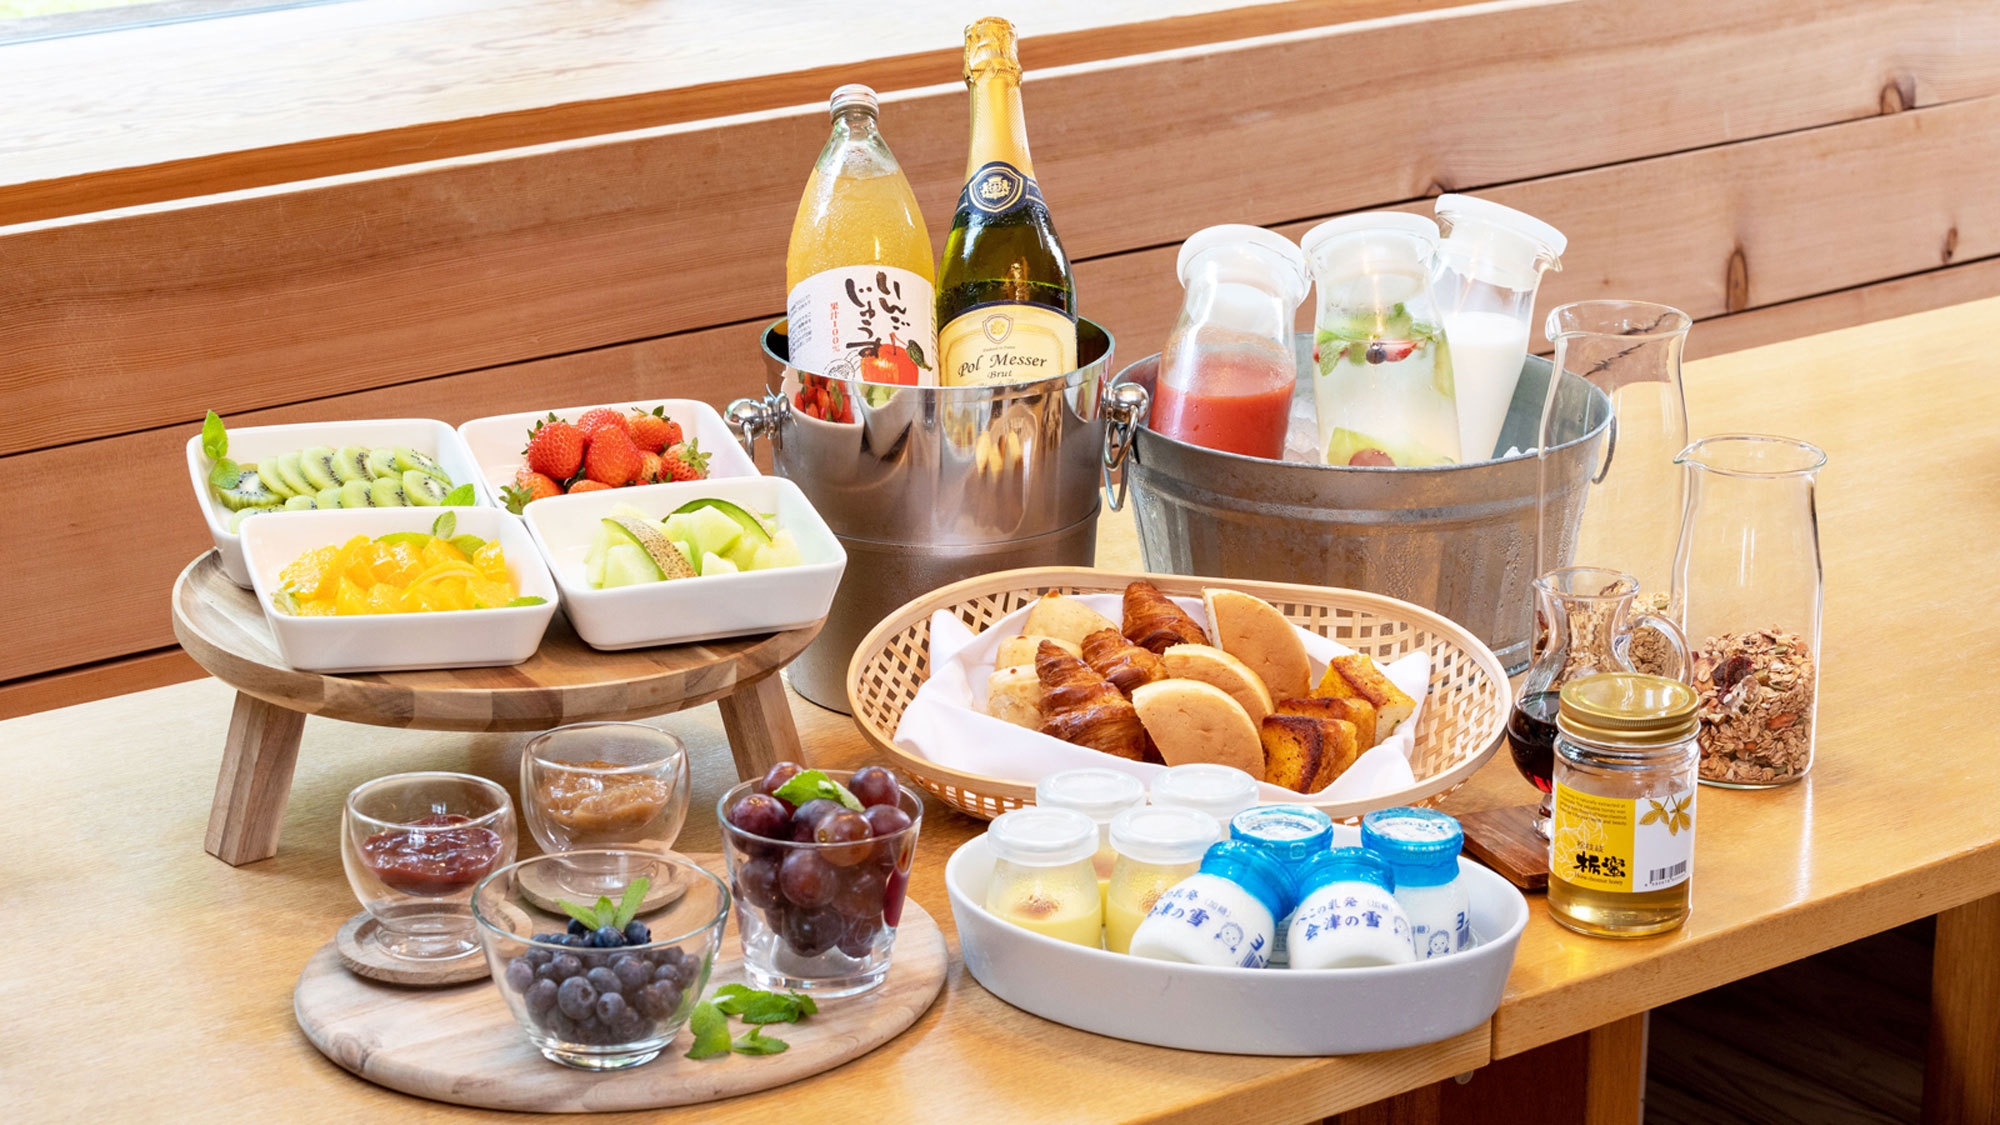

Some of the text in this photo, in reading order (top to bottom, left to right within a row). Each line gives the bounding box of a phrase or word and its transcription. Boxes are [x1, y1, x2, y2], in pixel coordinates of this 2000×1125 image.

[876, 271, 911, 331] りんご
[958, 352, 1047, 377] Pol Messer
[987, 370, 1012, 379] Brut
[1305, 910, 1383, 941] 会津の雪
